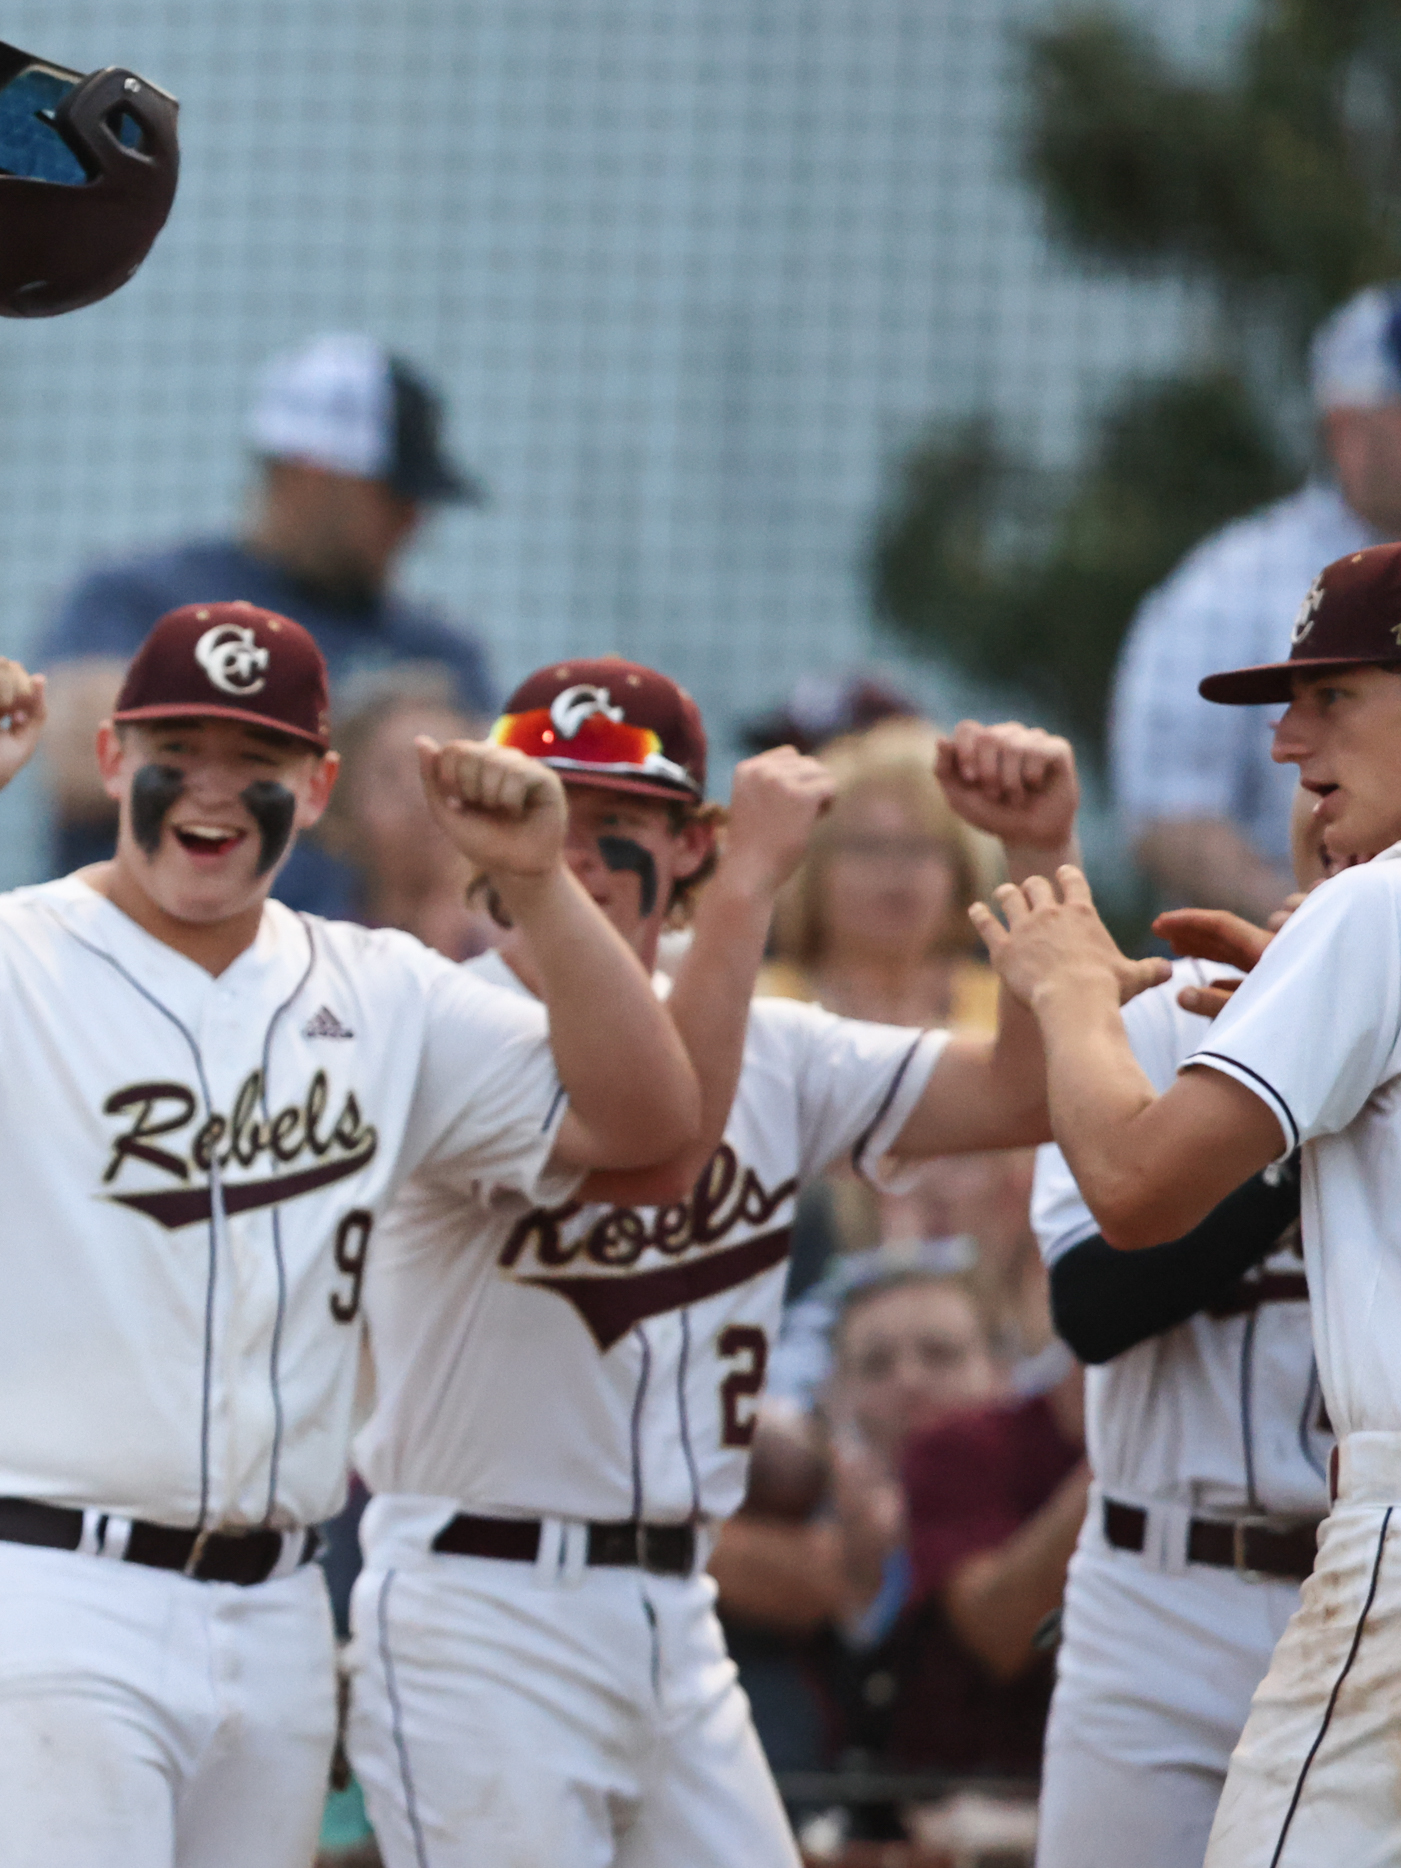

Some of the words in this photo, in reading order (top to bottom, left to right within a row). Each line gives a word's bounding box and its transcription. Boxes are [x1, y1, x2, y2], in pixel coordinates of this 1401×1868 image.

[102, 1068, 377, 1187] Rebels
[330, 1207, 373, 1325] 9
[716, 1323, 768, 1448] 2
